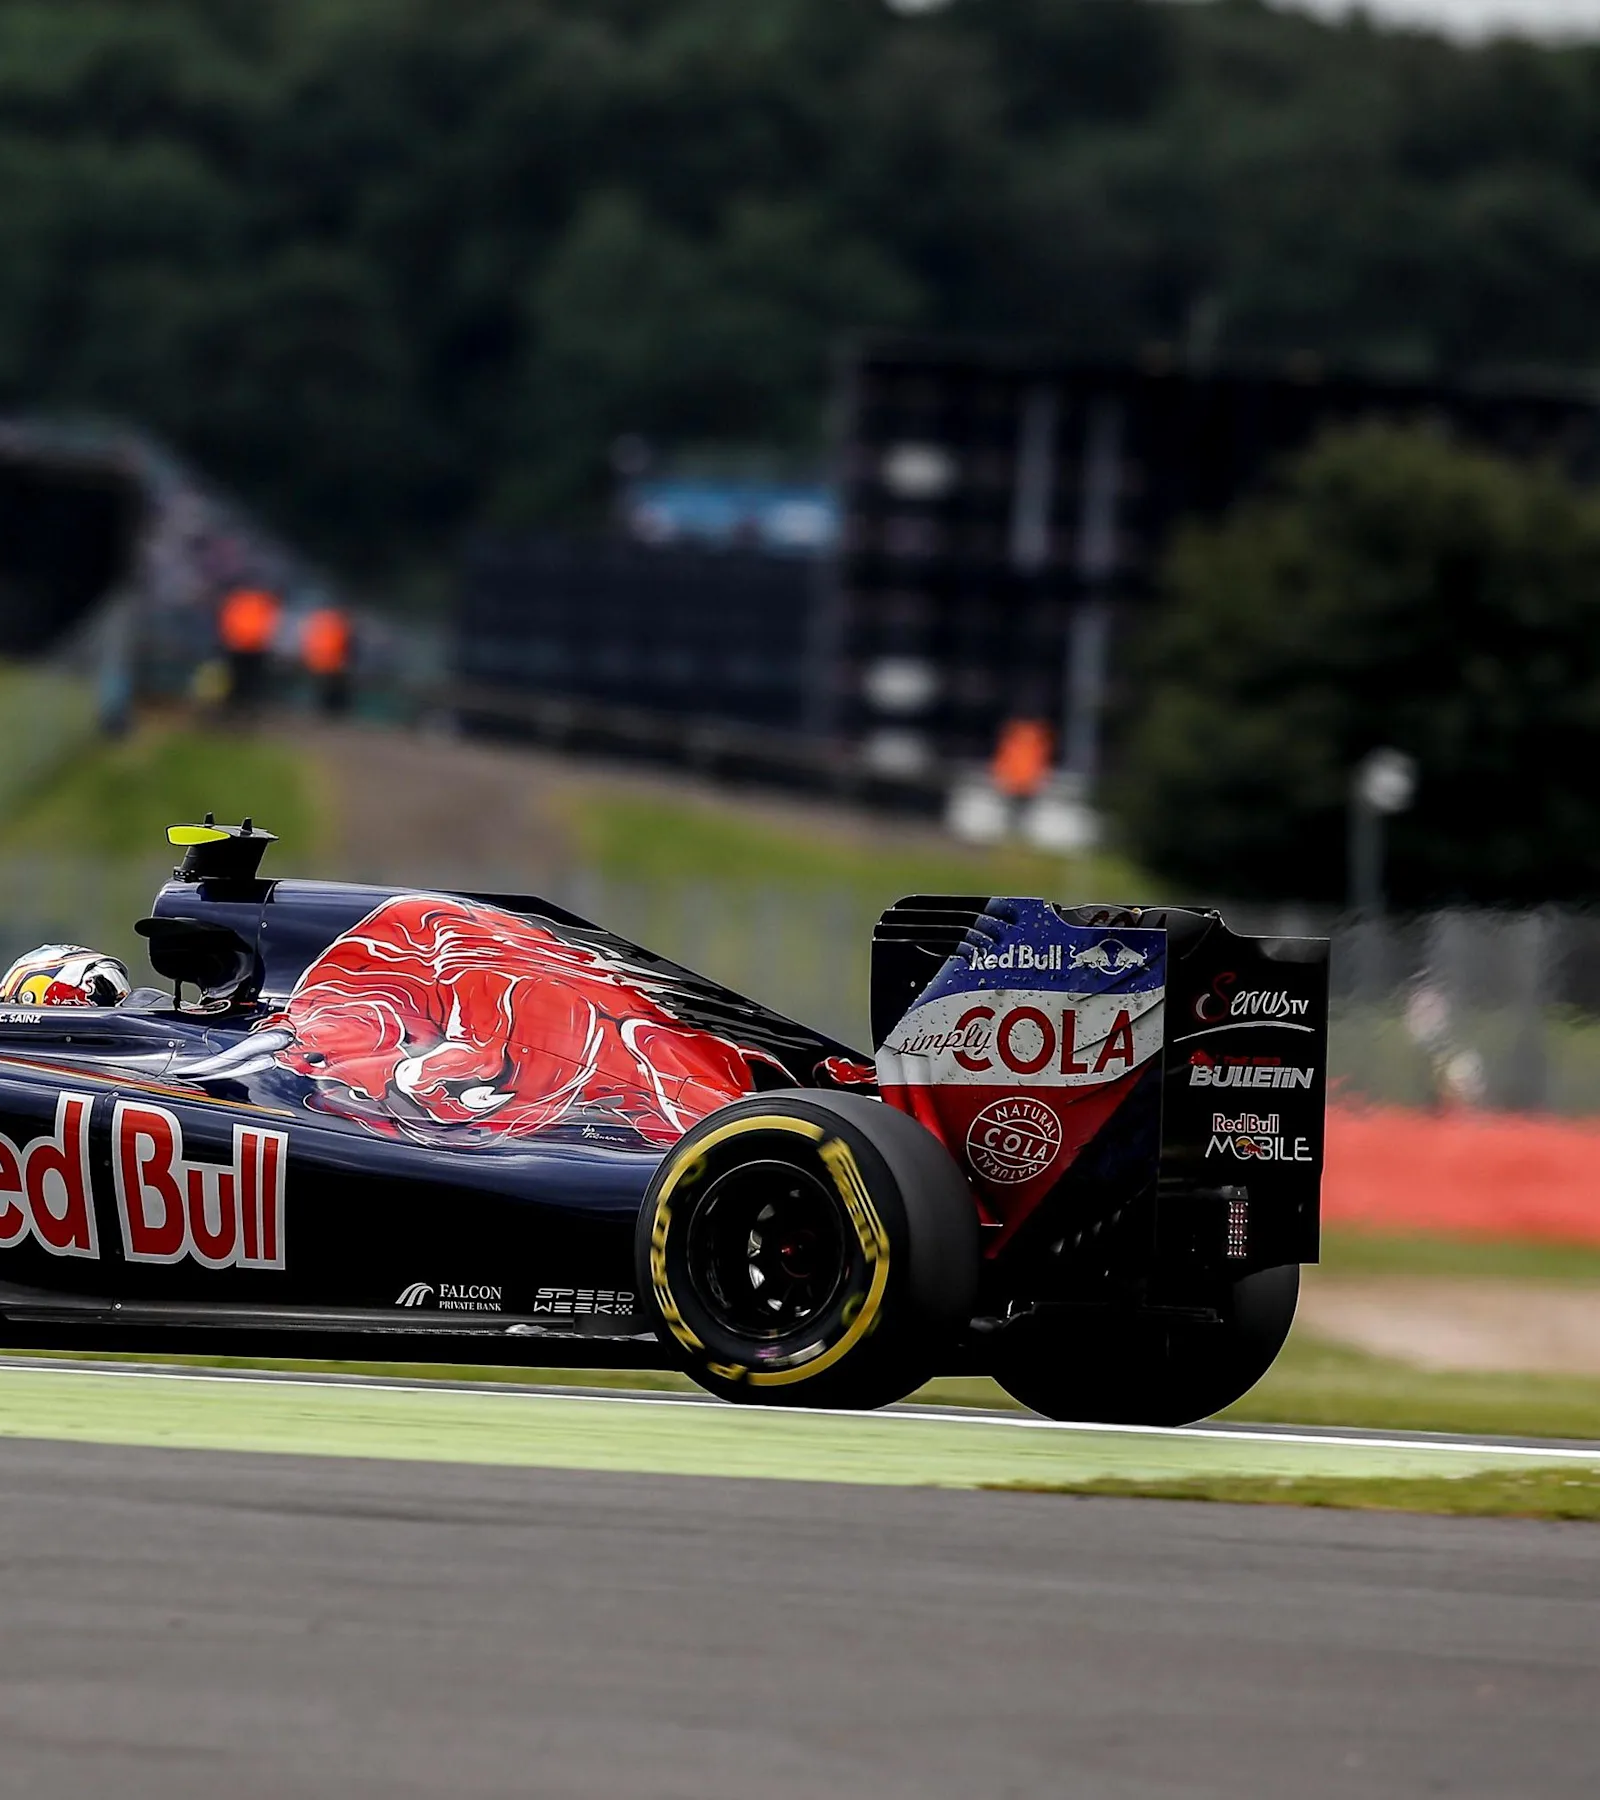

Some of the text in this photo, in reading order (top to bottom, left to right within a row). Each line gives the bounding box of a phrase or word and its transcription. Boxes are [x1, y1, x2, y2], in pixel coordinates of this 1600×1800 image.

[968, 944, 1062, 971] Red Bull
[9, 1012, 43, 1024] SAINZ
[897, 1022, 992, 1054] simply
[953, 1005, 1136, 1075] COLA
[995, 1104, 1057, 1138] NATURAL
[1212, 1112, 1280, 1134] Red Bull
[984, 1127, 1048, 1160] COLA
[1205, 1134, 1313, 1161] MOBILE
[976, 1152, 1038, 1179] NATURAL
[112, 1099, 289, 1271] Bull
[439, 1283, 503, 1300] FALCON
[535, 1287, 635, 1302] SPEED
[438, 1300, 502, 1312] PRIVATE BANK
[533, 1301, 613, 1315] WEEK
